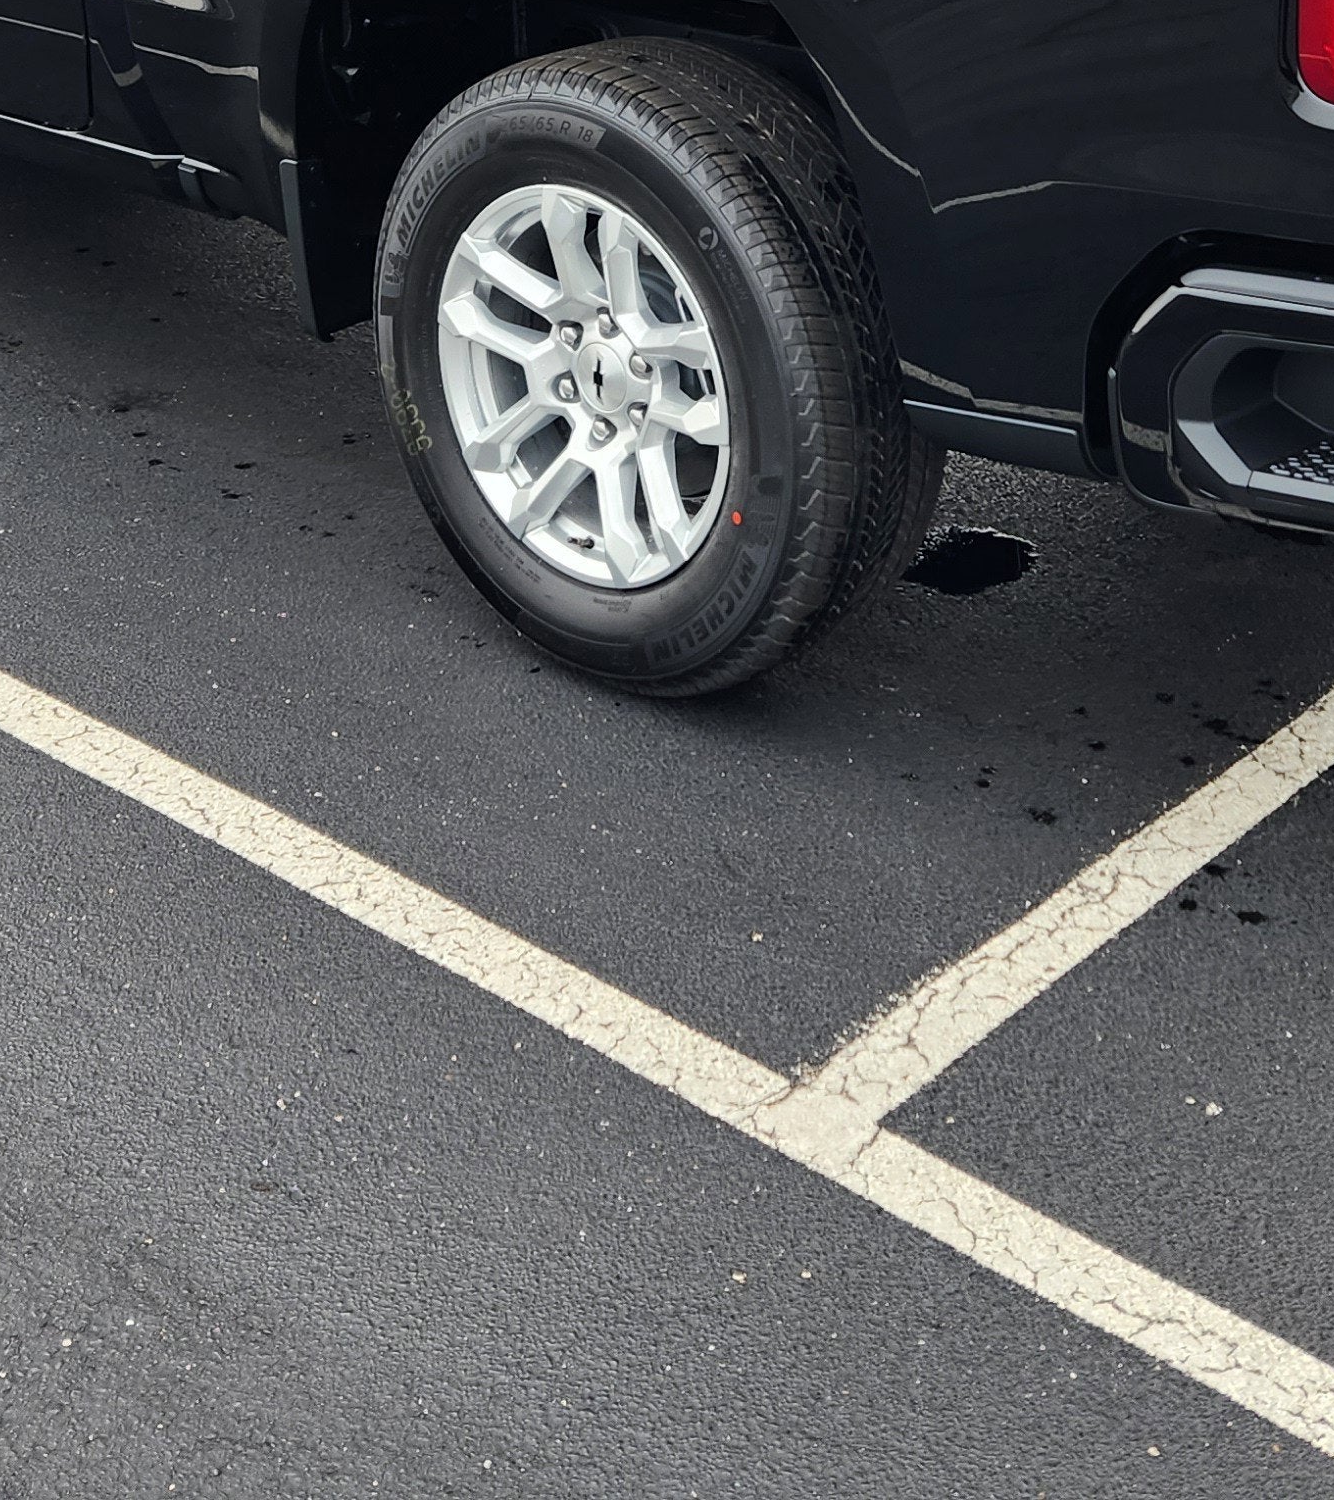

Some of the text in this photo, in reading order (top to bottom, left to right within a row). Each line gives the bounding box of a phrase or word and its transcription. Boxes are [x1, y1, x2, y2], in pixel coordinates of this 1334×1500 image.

[559, 120, 572, 136] R
[577, 125, 594, 142] 18
[396, 130, 482, 248] MICHELIN
[646, 551, 759, 665] MICHELIN
